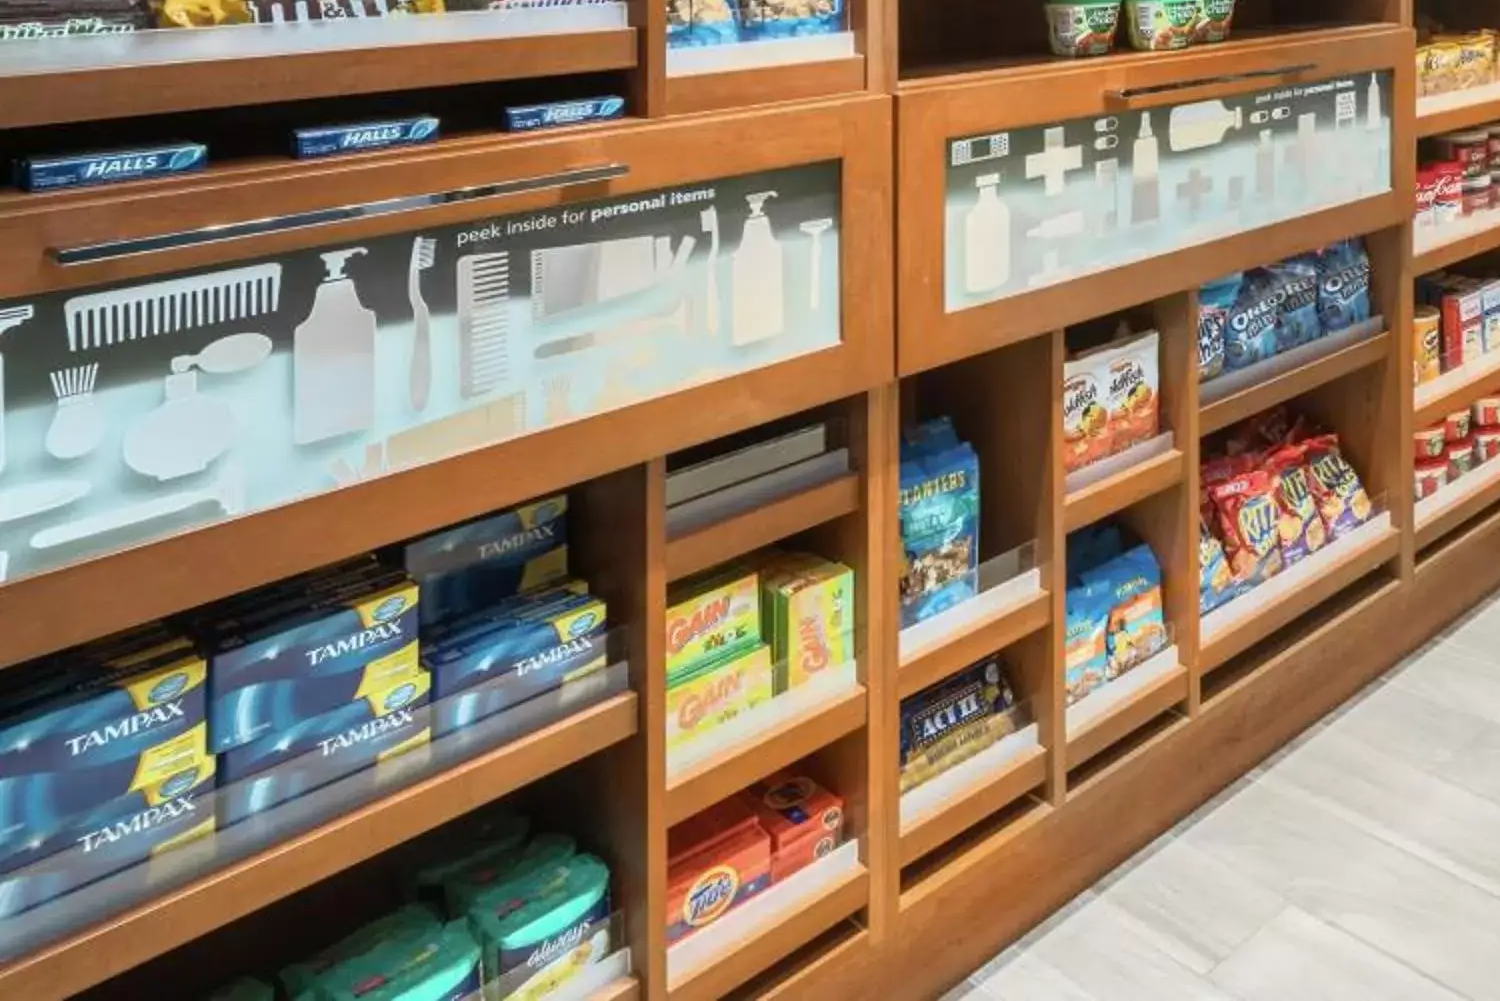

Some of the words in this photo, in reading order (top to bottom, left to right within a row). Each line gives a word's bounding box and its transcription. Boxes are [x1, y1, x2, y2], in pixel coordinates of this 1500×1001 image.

[342, 125, 402, 147] HALLS
[86, 155, 158, 178] HALLS
[457, 226, 501, 247] peek
[507, 213, 557, 235] inside
[562, 207, 586, 225] for
[591, 191, 666, 221] personal
[671, 186, 716, 205] items
[477, 521, 557, 560] TAMPAX
[304, 620, 403, 666] TAMPAX
[513, 635, 595, 678] TAMPAX
[64, 697, 186, 757] TAMPAX
[316, 707, 416, 757] TAMPAX
[76, 794, 197, 854] TAMPAX
